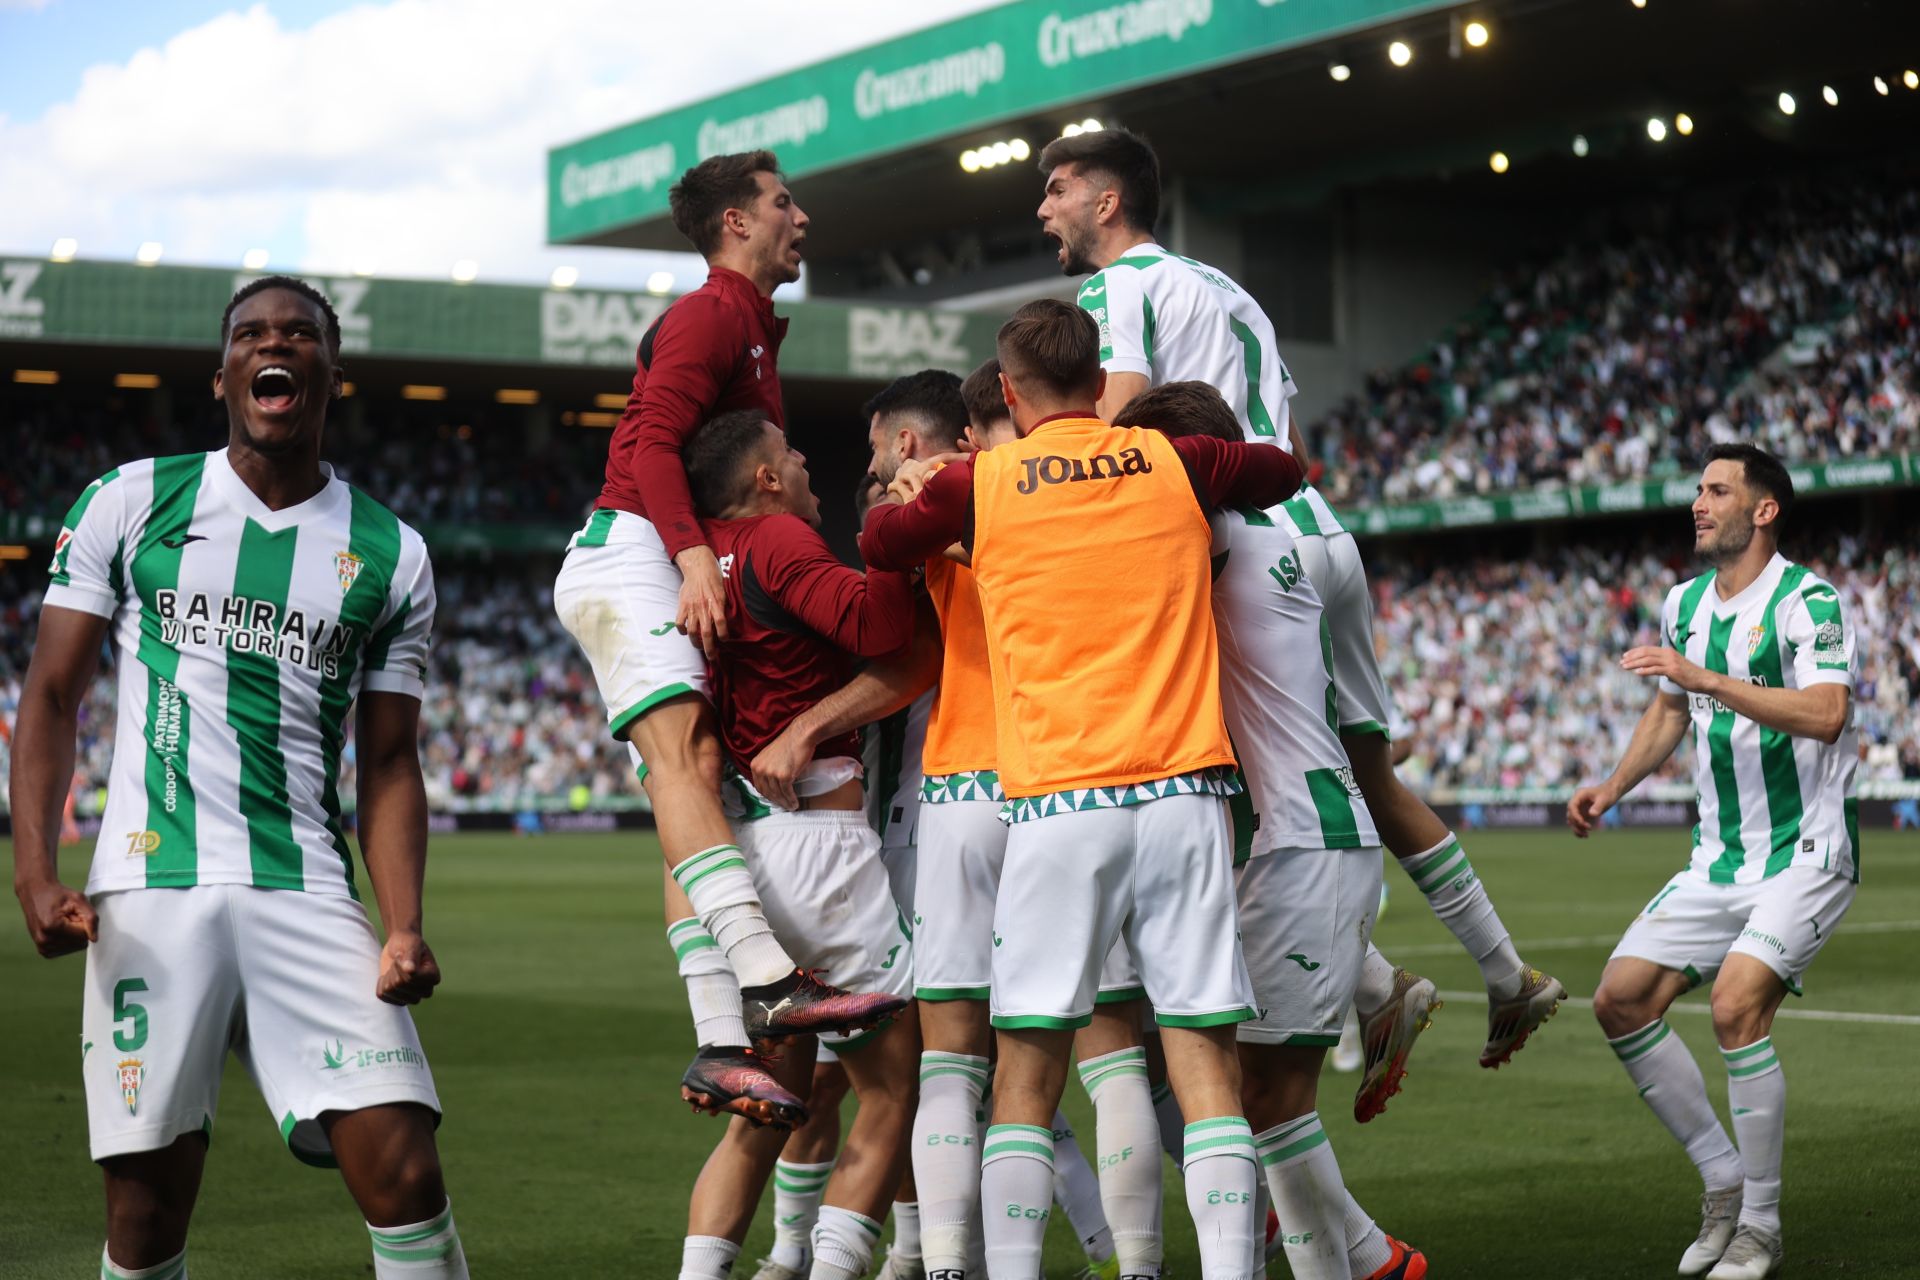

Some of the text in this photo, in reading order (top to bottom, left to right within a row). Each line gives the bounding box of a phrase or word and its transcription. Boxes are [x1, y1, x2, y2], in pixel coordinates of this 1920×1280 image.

[854, 42, 1005, 120] Cruzcampo
[561, 143, 675, 208] Cruzcampo
[849, 308, 969, 360] DIAZ
[156, 589, 352, 656] BAHRAIN
[161, 620, 338, 679] VICTORIOUS
[112, 977, 149, 1053] 5
